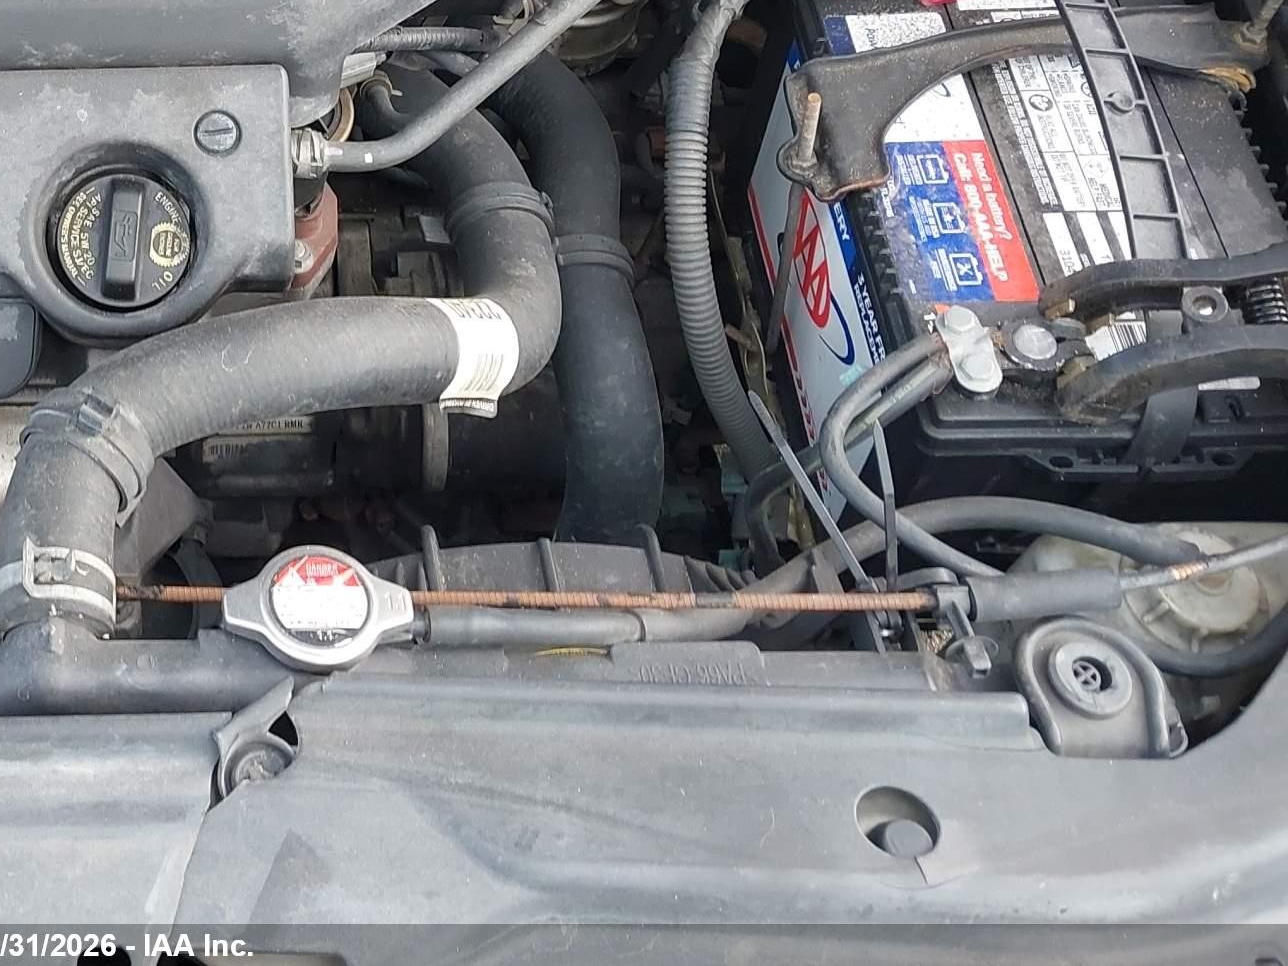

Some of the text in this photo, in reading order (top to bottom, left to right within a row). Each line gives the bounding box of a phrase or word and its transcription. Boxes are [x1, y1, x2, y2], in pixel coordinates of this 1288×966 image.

[954, 153, 973, 181] Call:
[971, 152, 992, 182] Need
[85, 192, 103, 209] API
[154, 191, 182, 224] ENGINE
[71, 206, 89, 248] SERVICE
[82, 206, 101, 228] SAE
[152, 271, 173, 291] OIL
[863, 286, 878, 334] YEAR
[873, 334, 887, 364] FR
